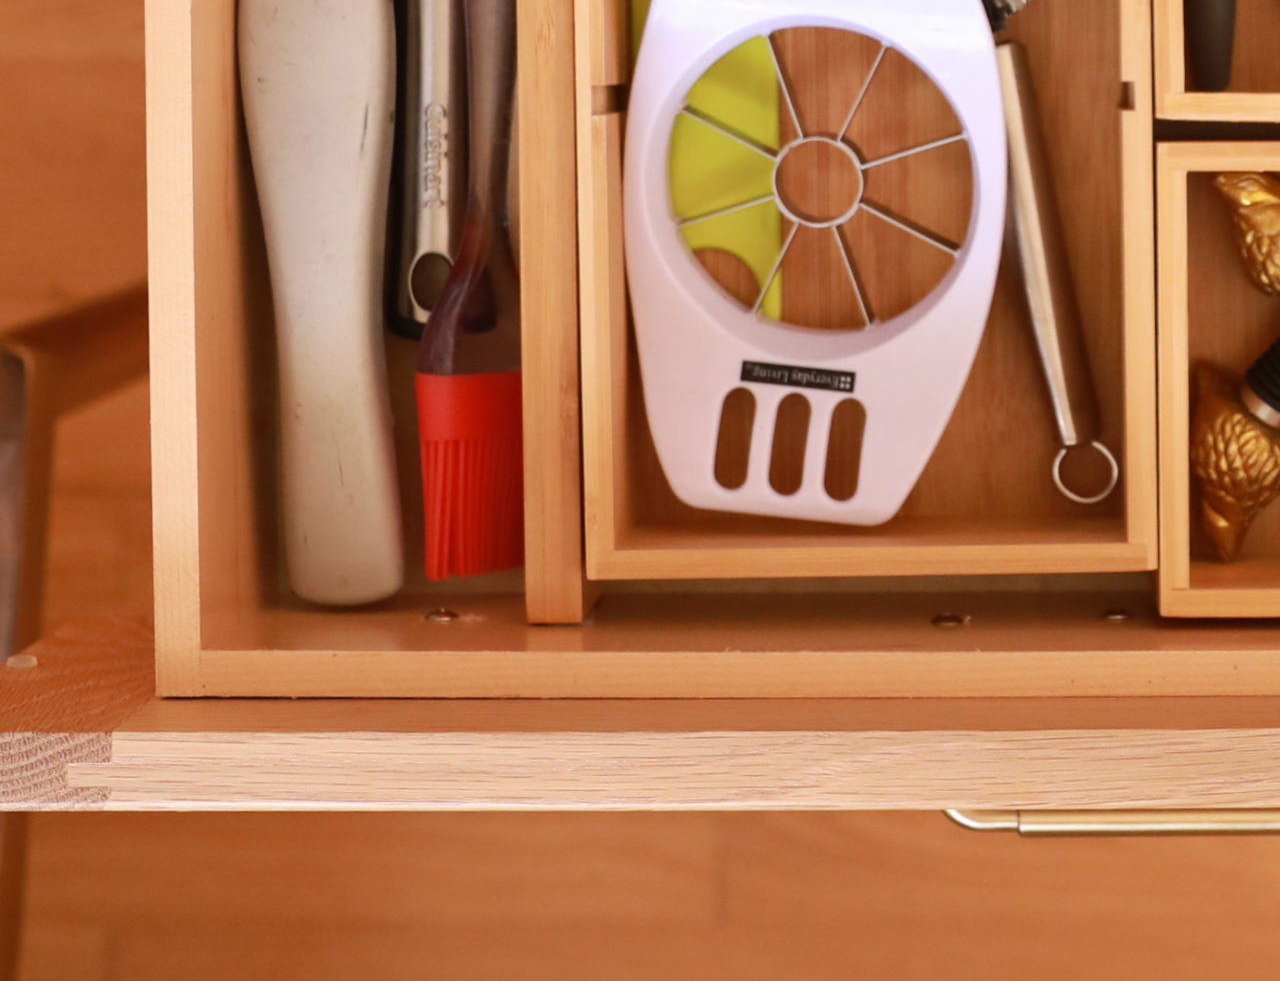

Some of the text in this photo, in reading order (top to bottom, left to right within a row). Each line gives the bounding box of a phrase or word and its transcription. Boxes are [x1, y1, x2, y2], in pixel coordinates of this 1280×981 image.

[424, 103, 447, 209] Cuisinart
[752, 364, 841, 389] Everyday Living
